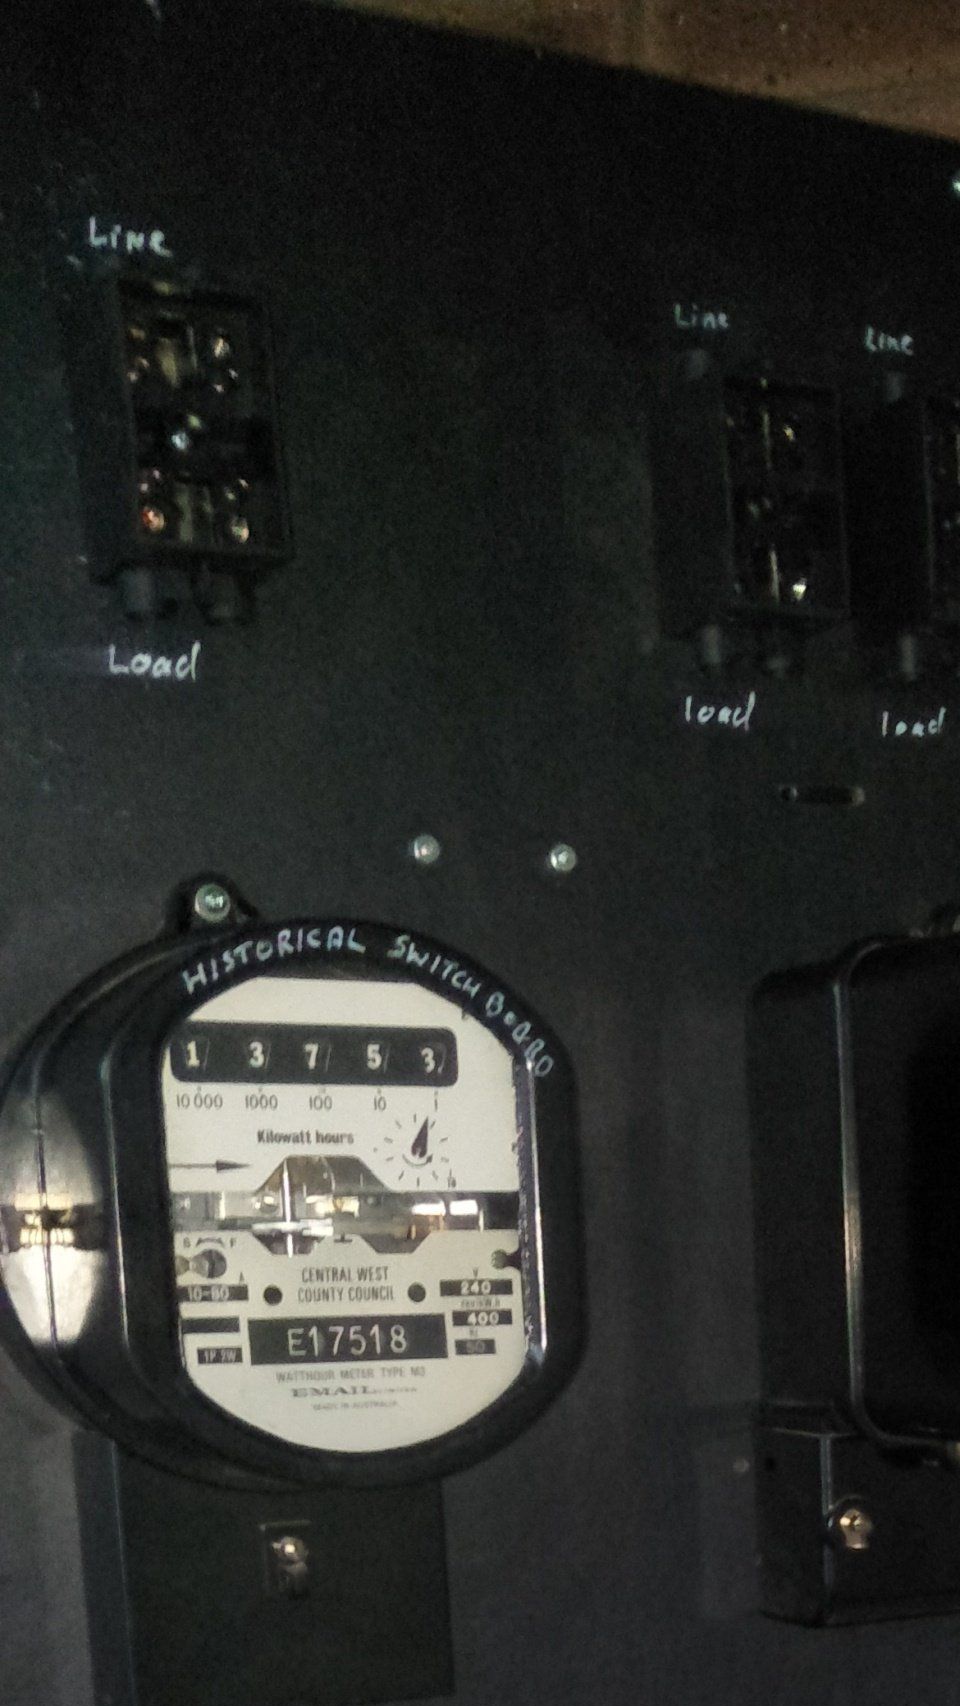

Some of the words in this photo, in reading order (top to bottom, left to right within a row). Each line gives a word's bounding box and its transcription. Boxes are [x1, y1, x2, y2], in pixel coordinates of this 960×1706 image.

[674, 303, 729, 330] Line
[108, 642, 201, 681] Load
[684, 690, 756, 732] load
[881, 706, 947, 738] load
[180, 926, 367, 995] HISTORICAL
[387, 934, 481, 998] SWITCH
[185, 1043, 202, 1068] 1
[249, 1041, 266, 1069] 3
[303, 1043, 320, 1069] 7
[366, 1044, 383, 1071] 5
[420, 1046, 437, 1074] 3
[244, 1094, 279, 1111] 1000
[309, 1094, 334, 1111] 100
[373, 1094, 388, 1112] 10
[256, 1128, 312, 1145] Kilowatt
[315, 1129, 355, 1145] hours
[301, 1265, 352, 1284] CENTRAL
[356, 1265, 389, 1282] WEST
[297, 1286, 344, 1304] COUNTY
[347, 1285, 395, 1303] COUNCIL
[460, 1279, 492, 1296] 240
[467, 1311, 500, 1326] 400
[286, 1323, 409, 1358] E17518
[339, 1367, 375, 1380] METER
[380, 1366, 404, 1378] TYPE
[291, 1384, 375, 1398] EMAIL
